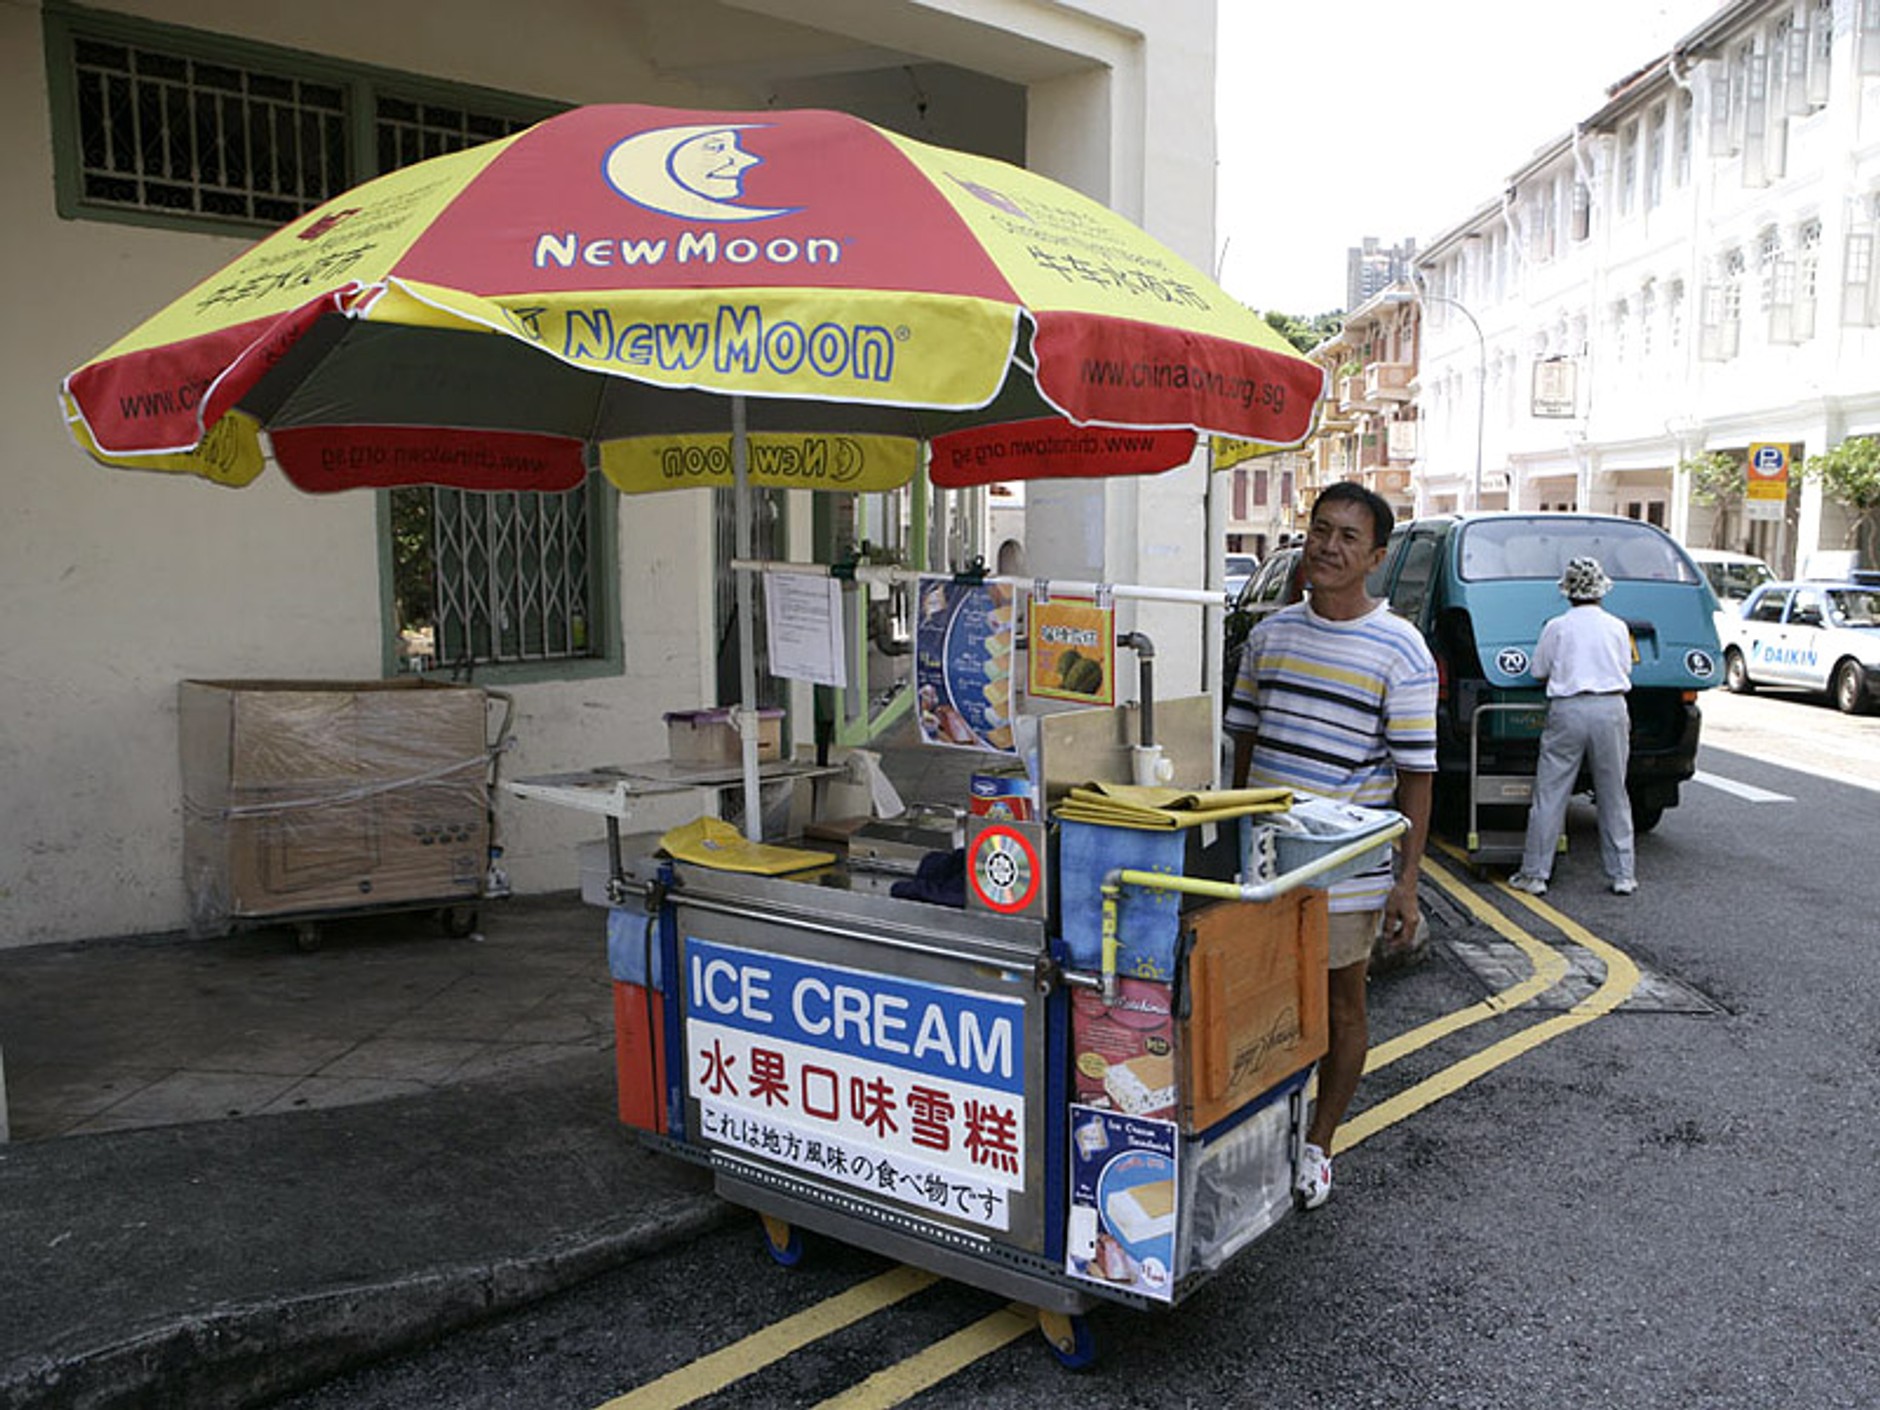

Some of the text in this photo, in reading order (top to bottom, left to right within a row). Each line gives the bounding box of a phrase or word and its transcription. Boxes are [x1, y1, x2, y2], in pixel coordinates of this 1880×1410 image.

[1764, 646, 1818, 667] DAIKIN
[692, 955, 773, 1024] ICE
[792, 977, 1013, 1079] CREAM
[699, 1038, 1020, 1176] 水果口味雪糕
[703, 1108, 1003, 1221] これは地方風味の食べ物です
